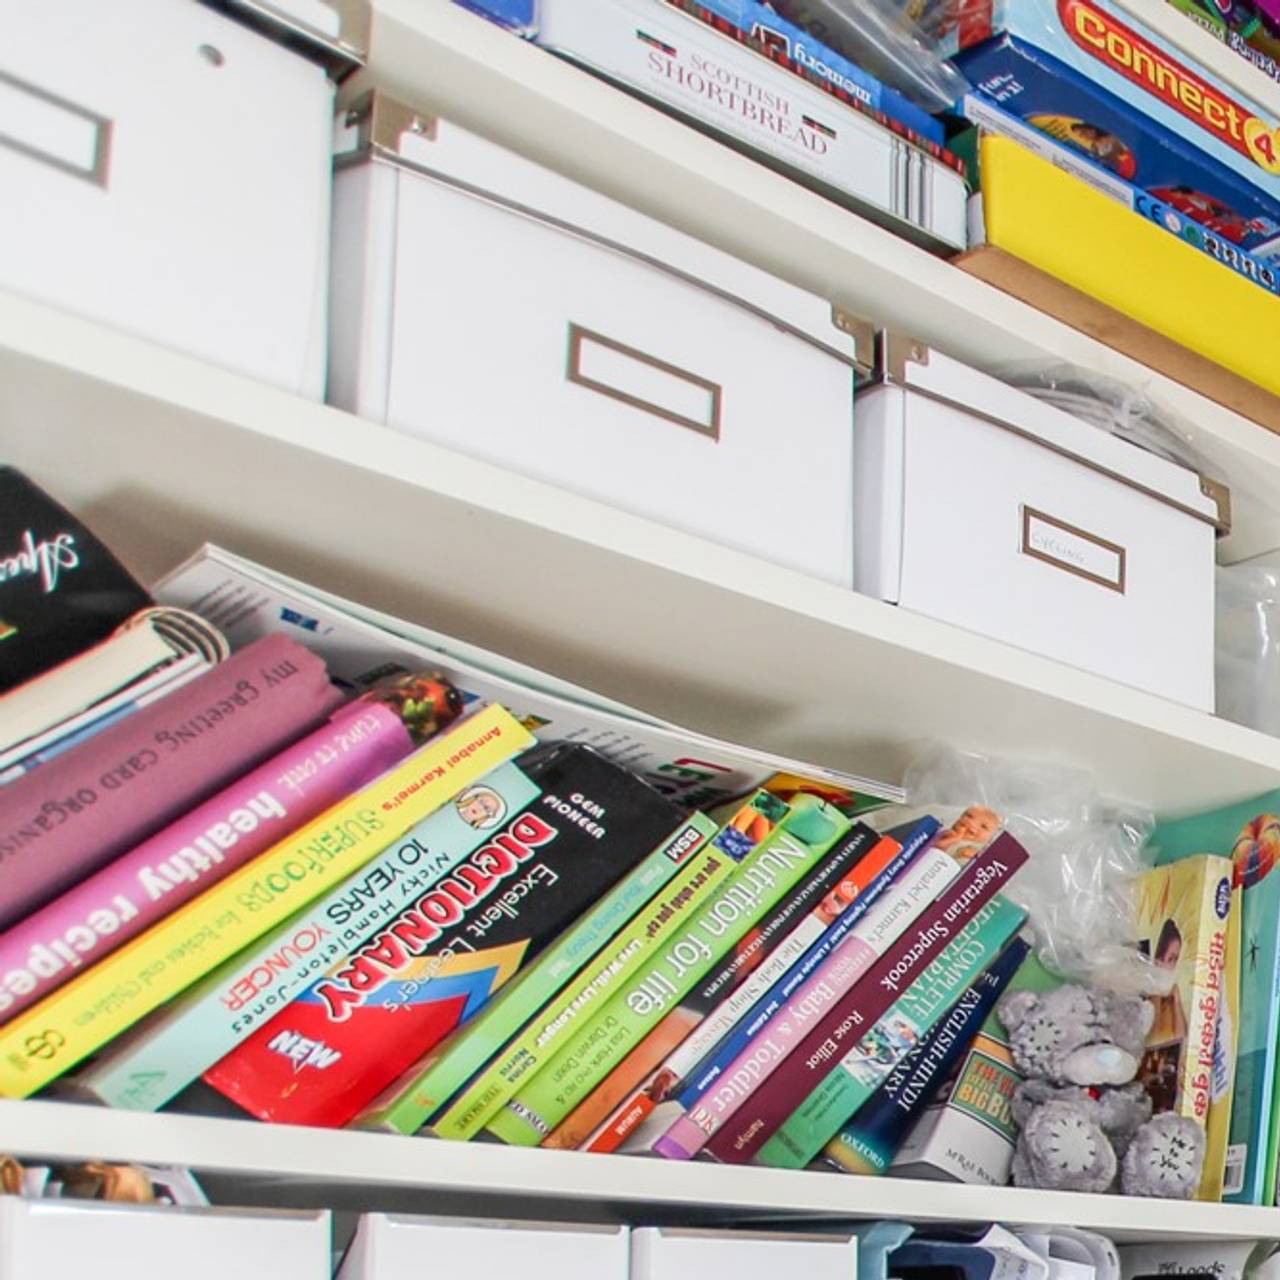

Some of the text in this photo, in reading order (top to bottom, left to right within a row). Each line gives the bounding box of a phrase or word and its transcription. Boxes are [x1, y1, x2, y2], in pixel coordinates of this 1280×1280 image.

[647, 52, 828, 156] SHORTBREAD
[689, 53, 791, 115] SCOTTISH
[793, 43, 872, 106] memory
[1074, 7, 1244, 137] Connect
[1257, 131, 1277, 164] 4
[264, 661, 298, 688] my
[381, 726, 502, 812] Annabel Karmel's
[542, 793, 607, 840] PIONEER
[568, 792, 606, 819] GEM
[138, 790, 289, 901] healthy
[396, 838, 430, 865] 10
[667, 829, 700, 859] BSM
[326, 867, 395, 927] YEARS
[904, 856, 951, 902] Annabel
[946, 859, 1008, 926] Vegetarian
[231, 851, 450, 1035] Nicky Hambleton-Jones
[313, 811, 560, 1023] DICTIONARY
[381, 862, 560, 1014] Excellent Learner's
[626, 836, 808, 1017] Nutrition for life
[616, 937, 642, 962] Live
[880, 923, 949, 991] Supercook
[916, 940, 985, 1018] COMPLETE
[532, 1005, 574, 1047] Longer
[569, 985, 594, 1011] Live
[785, 976, 837, 1028] Baby
[838, 1010, 865, 1039] Rose
[267, 1029, 343, 1071] NEW
[716, 1038, 784, 1113] Toddler
[807, 1036, 839, 1069] Elliot
[898, 987, 983, 1112] ENGLISH-HINDI
[617, 1104, 644, 1136] AURUM
[839, 1132, 886, 1167] OXFORD
